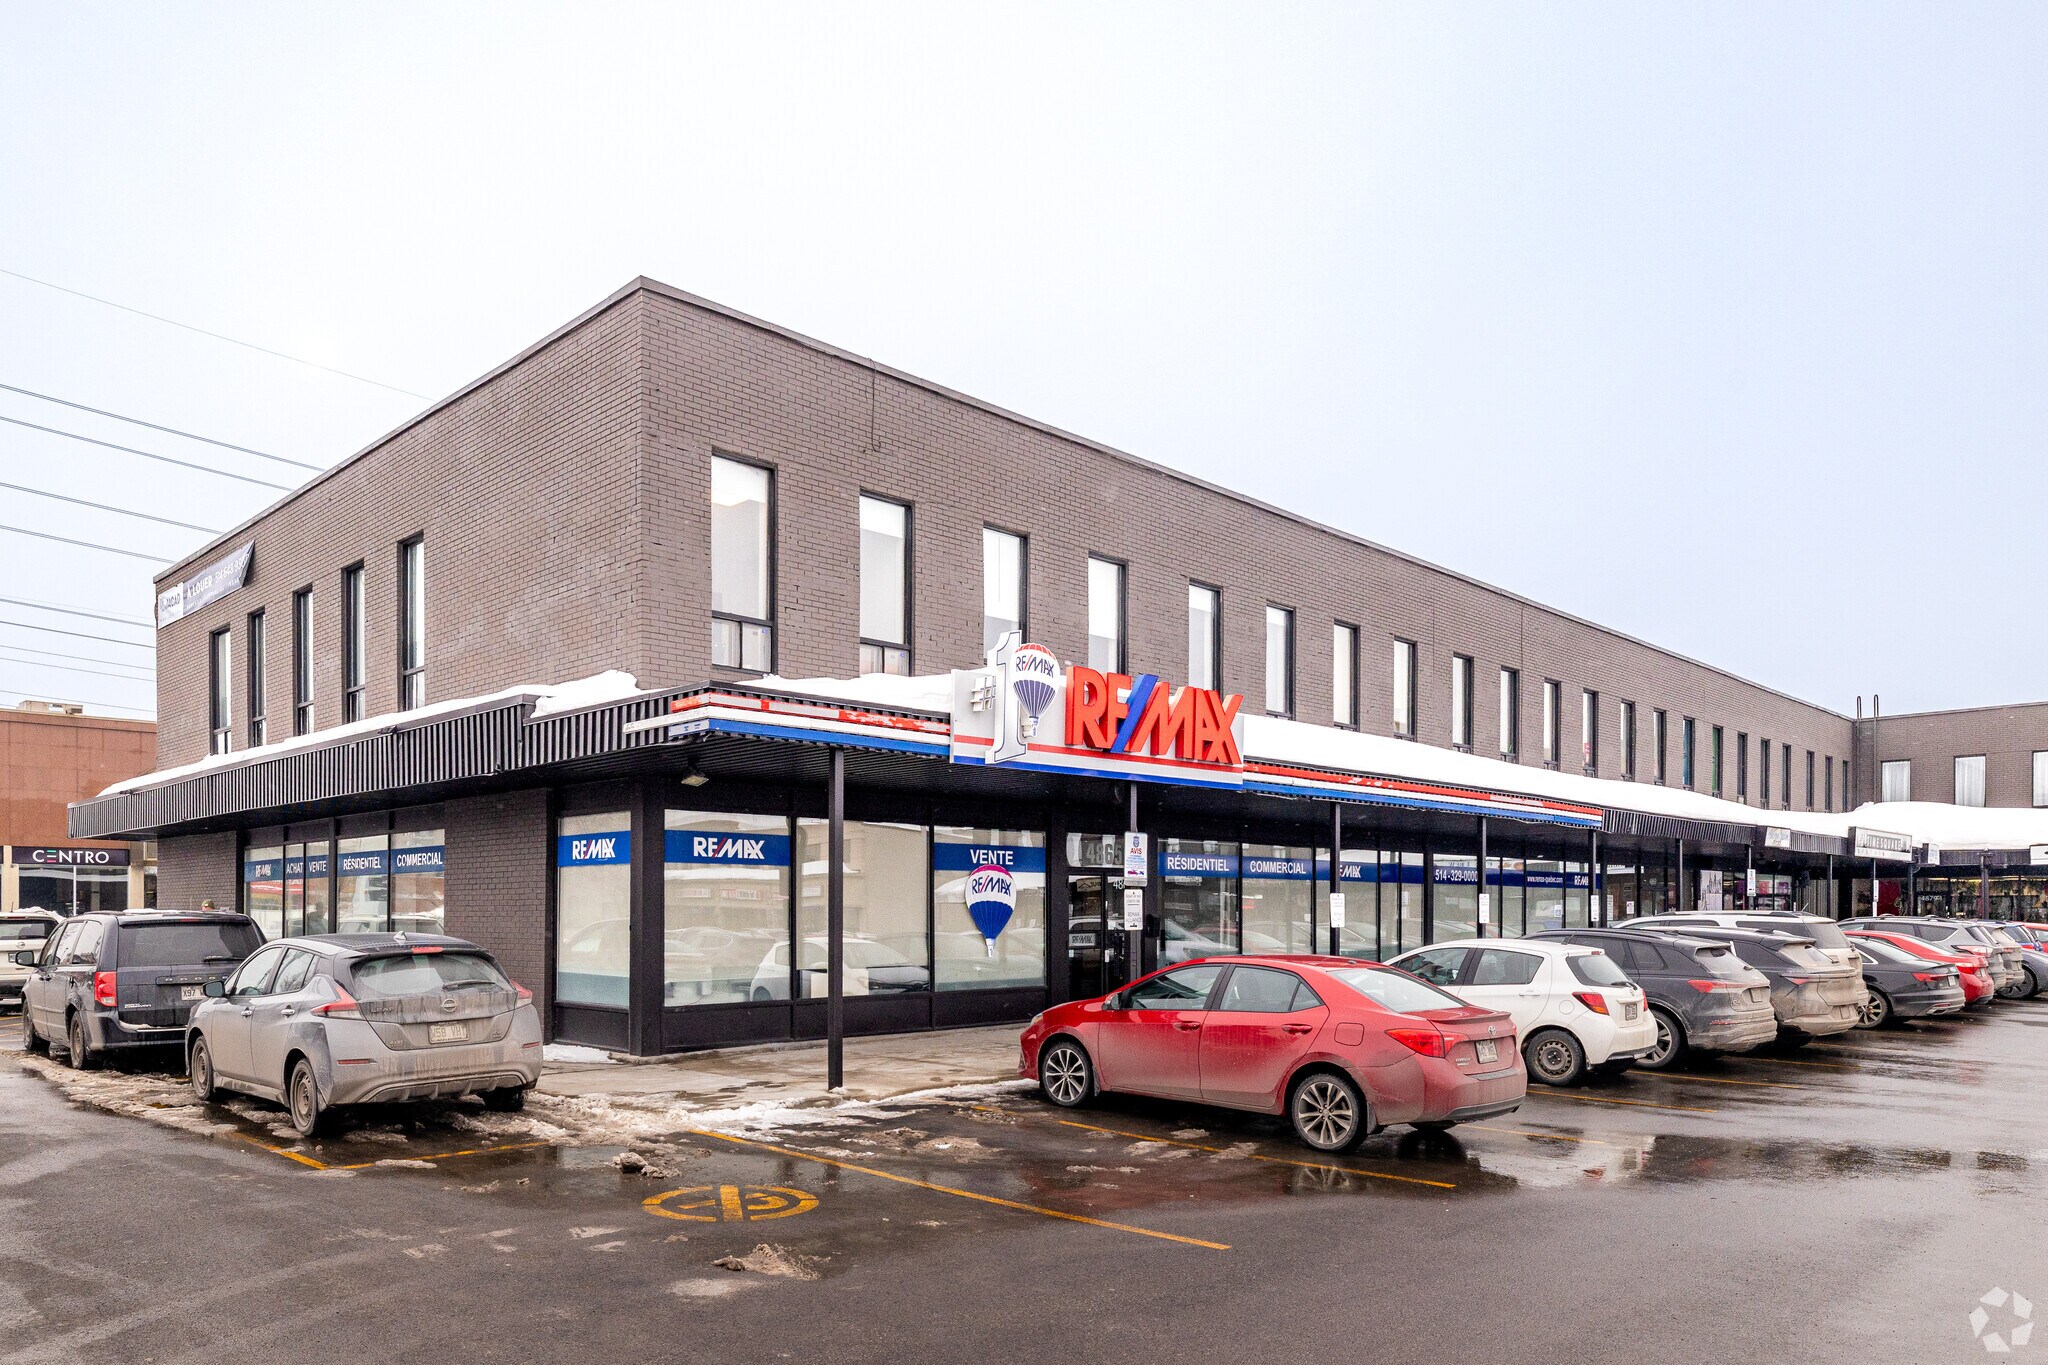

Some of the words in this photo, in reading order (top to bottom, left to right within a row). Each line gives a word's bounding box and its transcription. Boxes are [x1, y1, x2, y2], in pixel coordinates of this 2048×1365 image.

[192, 575, 213, 596] LOUER
[1016, 654, 1054, 678] RE/MAX
[1065, 666, 1244, 765] RE/MAX
[32, 849, 109, 864] CENTRO
[572, 837, 616, 860] RE/MAX
[693, 836, 765, 860] RE/MAX
[970, 849, 1014, 865] VENTE
[1086, 843, 1124, 866] 4865
[286, 862, 303, 875] ACHAT
[308, 860, 327, 873] VENTE
[343, 856, 382, 871] RÉSIDENTIEL
[396, 852, 443, 867] COMMERCIAL
[1167, 856, 1230, 872] RÉSIDENTIEL
[1250, 860, 1307, 875] COMMERCIAL
[972, 875, 1012, 897] RE/MAX
